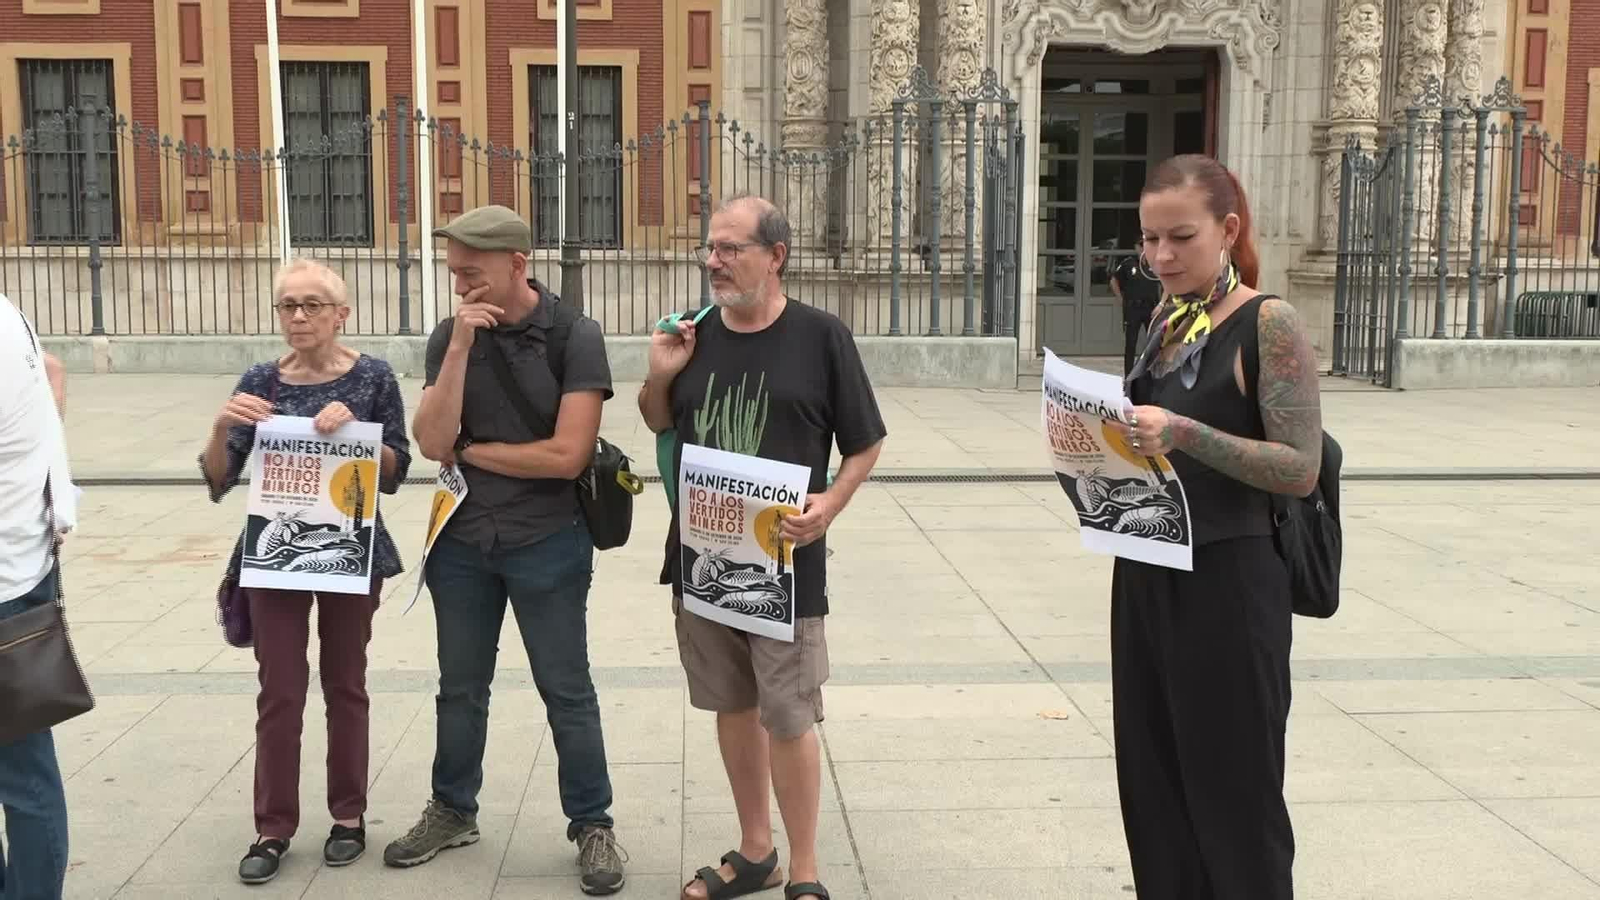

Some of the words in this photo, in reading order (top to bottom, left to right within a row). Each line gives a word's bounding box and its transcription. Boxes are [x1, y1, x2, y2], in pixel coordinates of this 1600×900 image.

[259, 438, 375, 459] MANIFESTACIÓN
[263, 453, 284, 467] NO
[286, 454, 295, 468] A
[297, 455, 322, 470] LOS
[263, 466, 321, 483] VERTIDOS
[261, 479, 320, 495] MINEROS
[685, 469, 800, 505] MANIFESTACIÓN
[688, 486, 707, 502] NO
[709, 491, 718, 504] A
[720, 493, 744, 509] LOS
[689, 501, 745, 522] VERTIDOS
[689, 513, 744, 534] MINEROS
